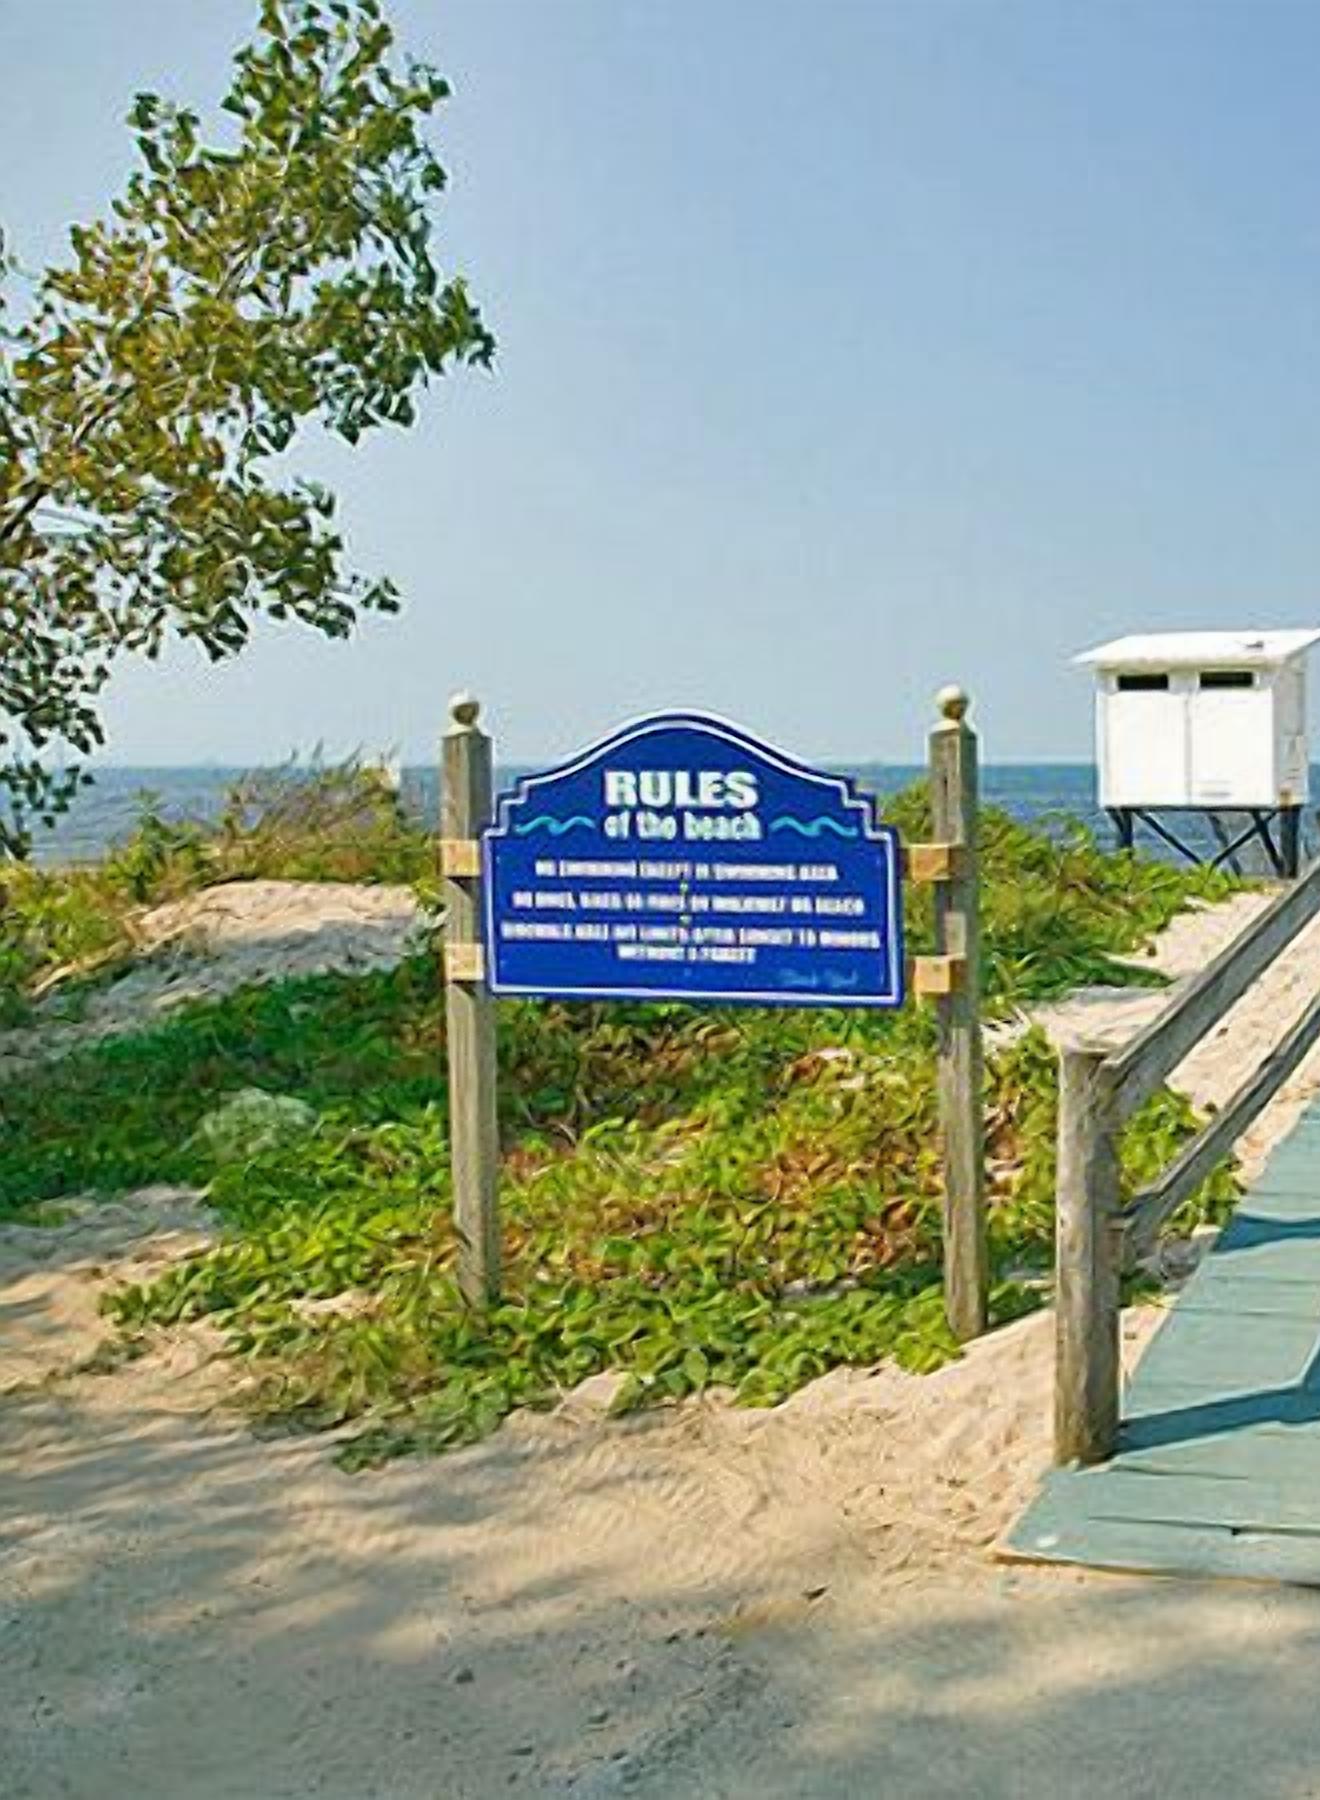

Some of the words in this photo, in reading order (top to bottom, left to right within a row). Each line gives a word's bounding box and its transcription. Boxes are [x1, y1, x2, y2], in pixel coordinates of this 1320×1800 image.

[605, 771, 758, 808] RULES
[604, 811, 630, 839] of
[636, 811, 677, 840] the
[684, 811, 761, 840] beach
